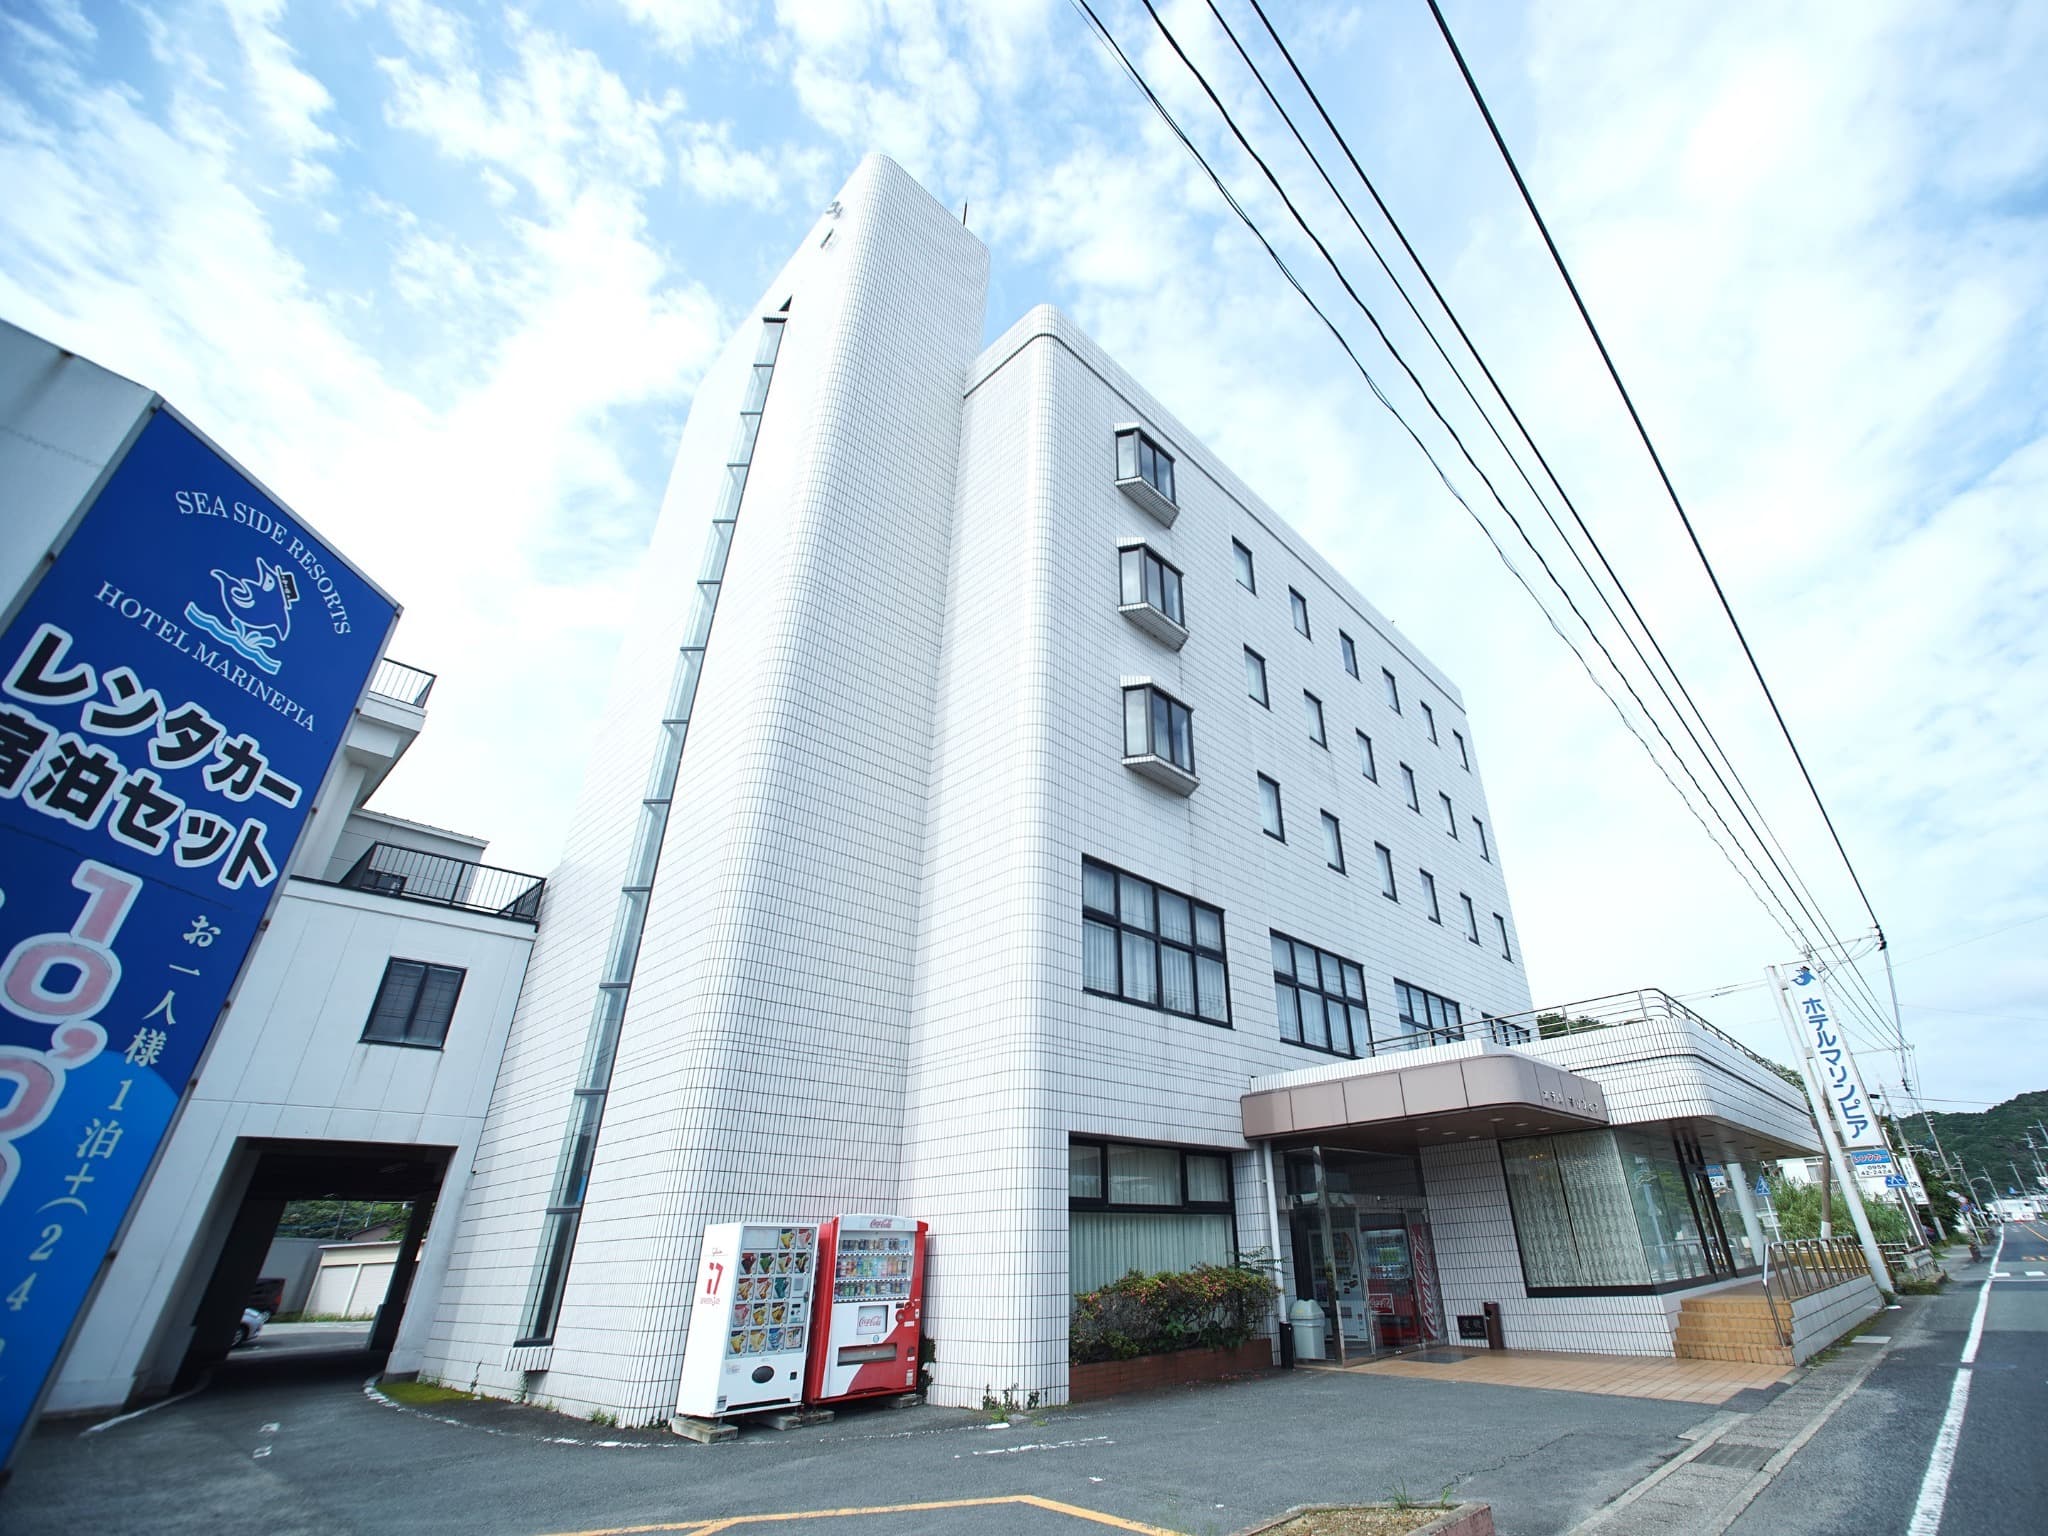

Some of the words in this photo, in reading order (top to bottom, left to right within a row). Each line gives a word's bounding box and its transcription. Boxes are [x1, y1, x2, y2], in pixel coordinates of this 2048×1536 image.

[175, 490, 229, 518] SEA
[233, 502, 288, 544] SIDE
[286, 536, 352, 636] RESORTS
[3, 624, 301, 807] レンタカー
[94, 581, 191, 654] HOTEL
[192, 642, 316, 733] MARINEPIA
[1802, 997, 1869, 1140] ホテルマリンピア
